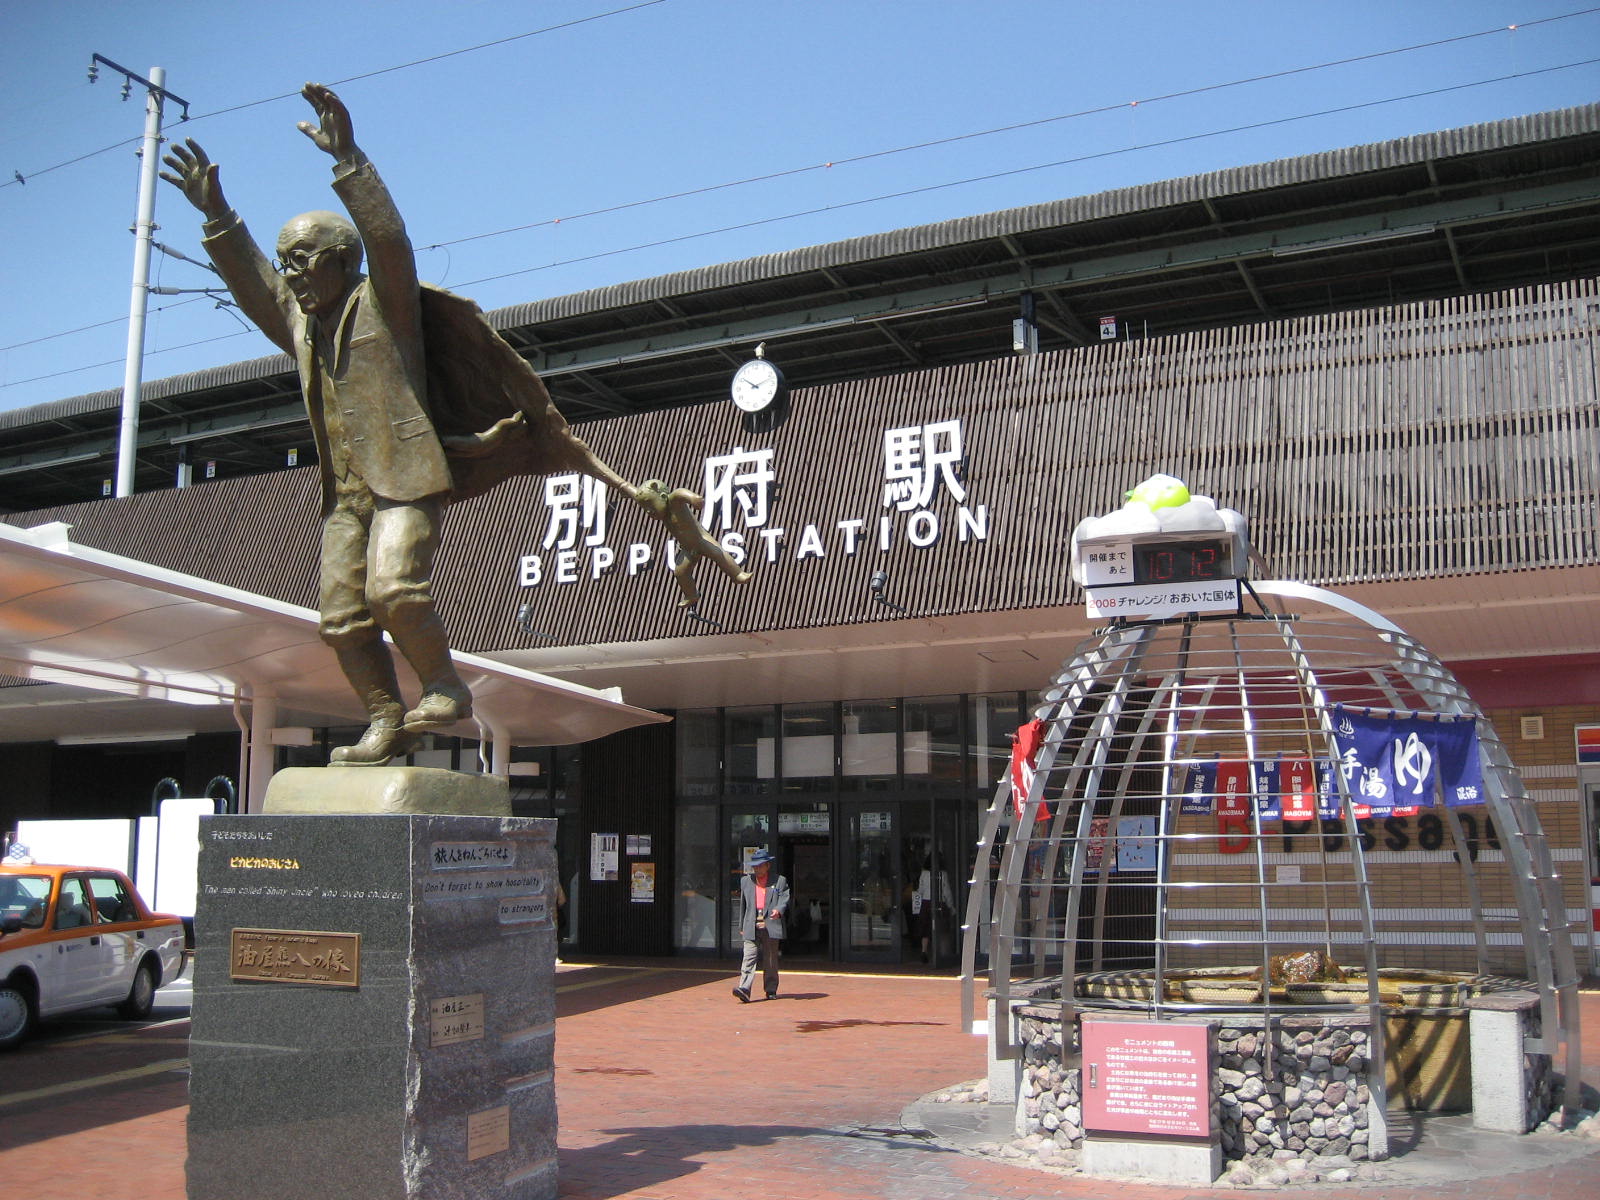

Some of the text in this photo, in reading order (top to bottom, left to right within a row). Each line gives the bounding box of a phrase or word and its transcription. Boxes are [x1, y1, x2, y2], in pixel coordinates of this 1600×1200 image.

[542, 419, 967, 552] 別府駅
[720, 504, 988, 565] STATION
[1089, 551, 1127, 563] 開催まで
[1109, 564, 1127, 575] あと
